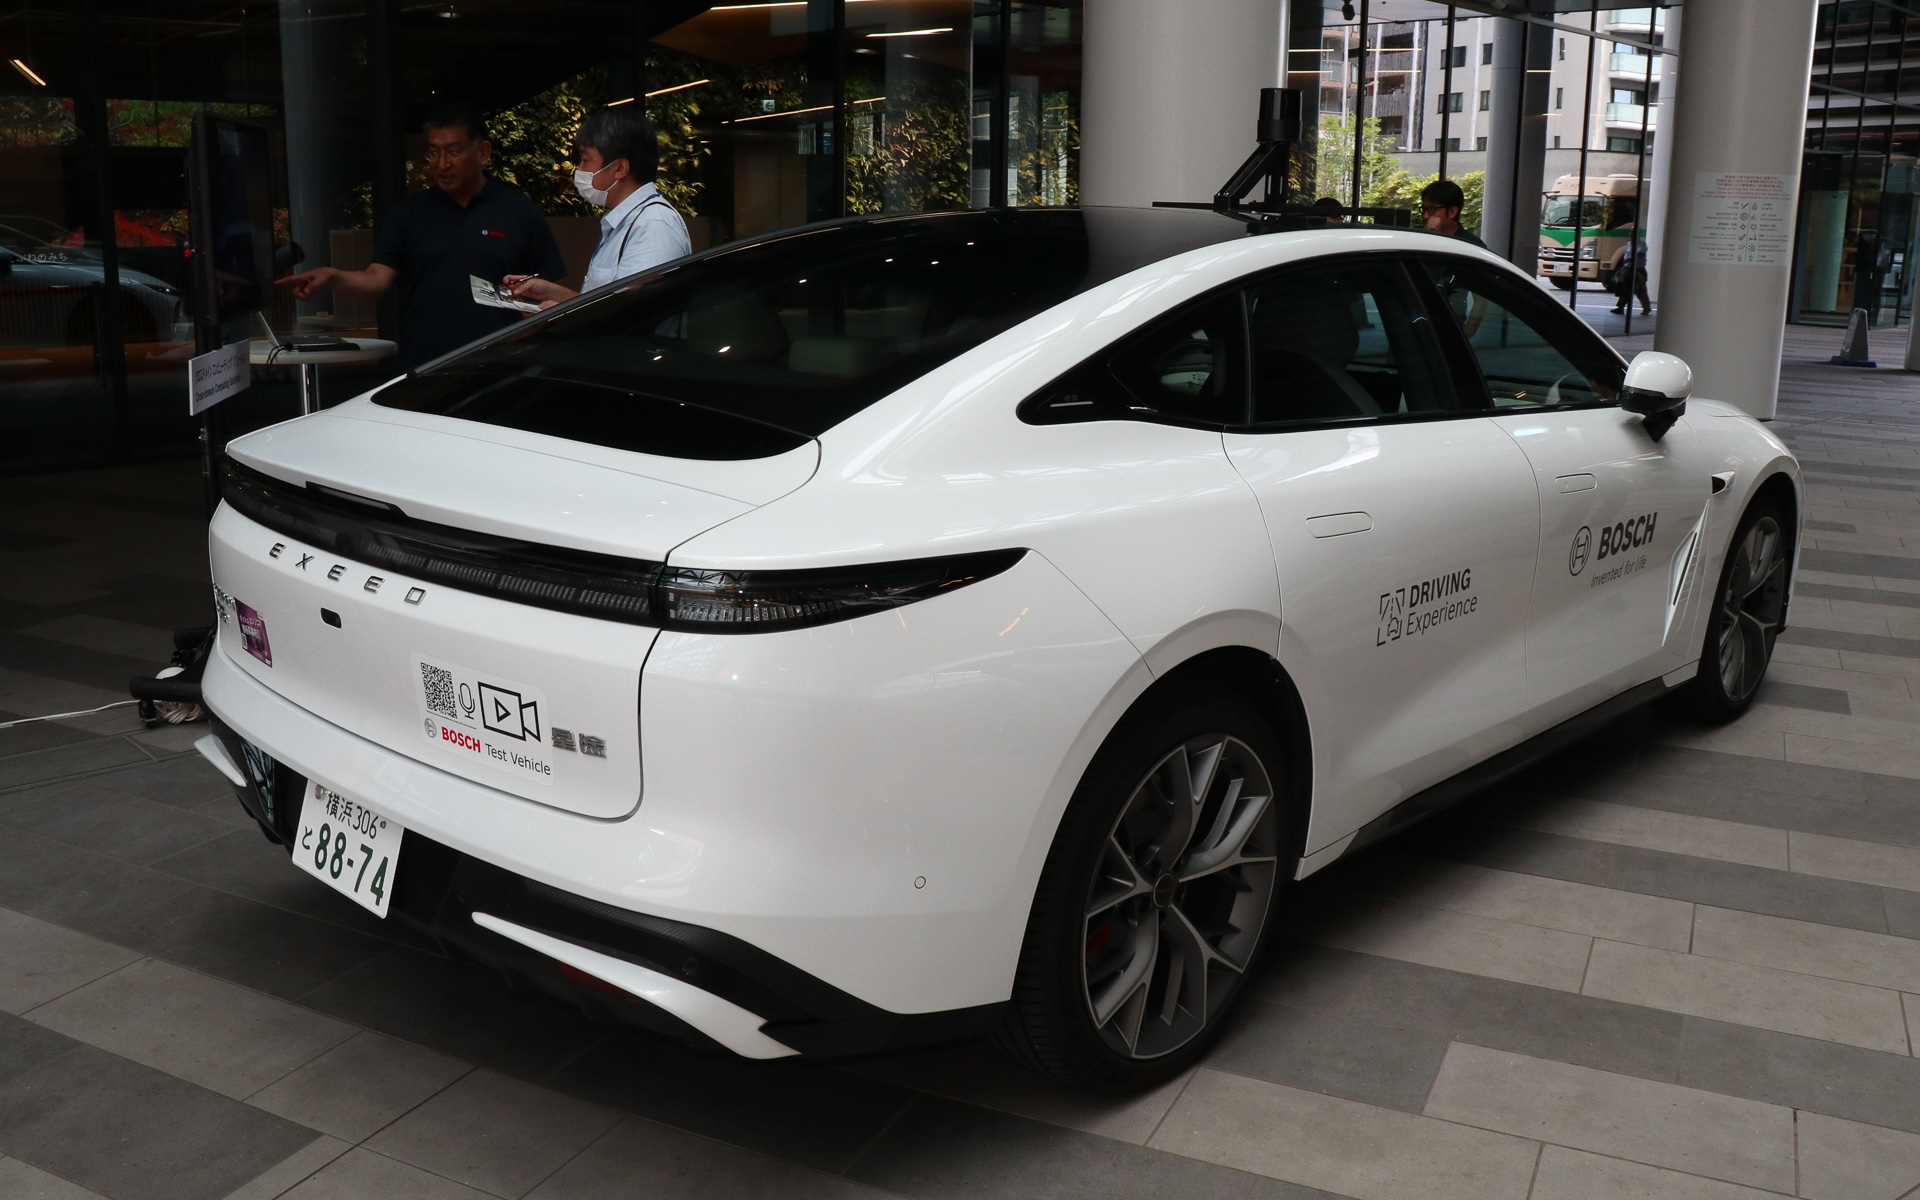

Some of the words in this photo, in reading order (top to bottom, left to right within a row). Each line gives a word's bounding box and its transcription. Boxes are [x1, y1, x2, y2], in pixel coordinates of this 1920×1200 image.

[1597, 512, 1658, 560] BOSCH
[1409, 568, 1471, 608] DRIVING
[1591, 562, 1624, 588] Invented
[1624, 560, 1635, 575] for
[1635, 555, 1647, 571] life
[1406, 595, 1478, 636] Experience
[441, 726, 481, 753] BOSCH
[484, 742, 507, 762] Test
[510, 751, 551, 776] Vehicle
[302, 825, 313, 850] と
[315, 823, 388, 906] 88-74
